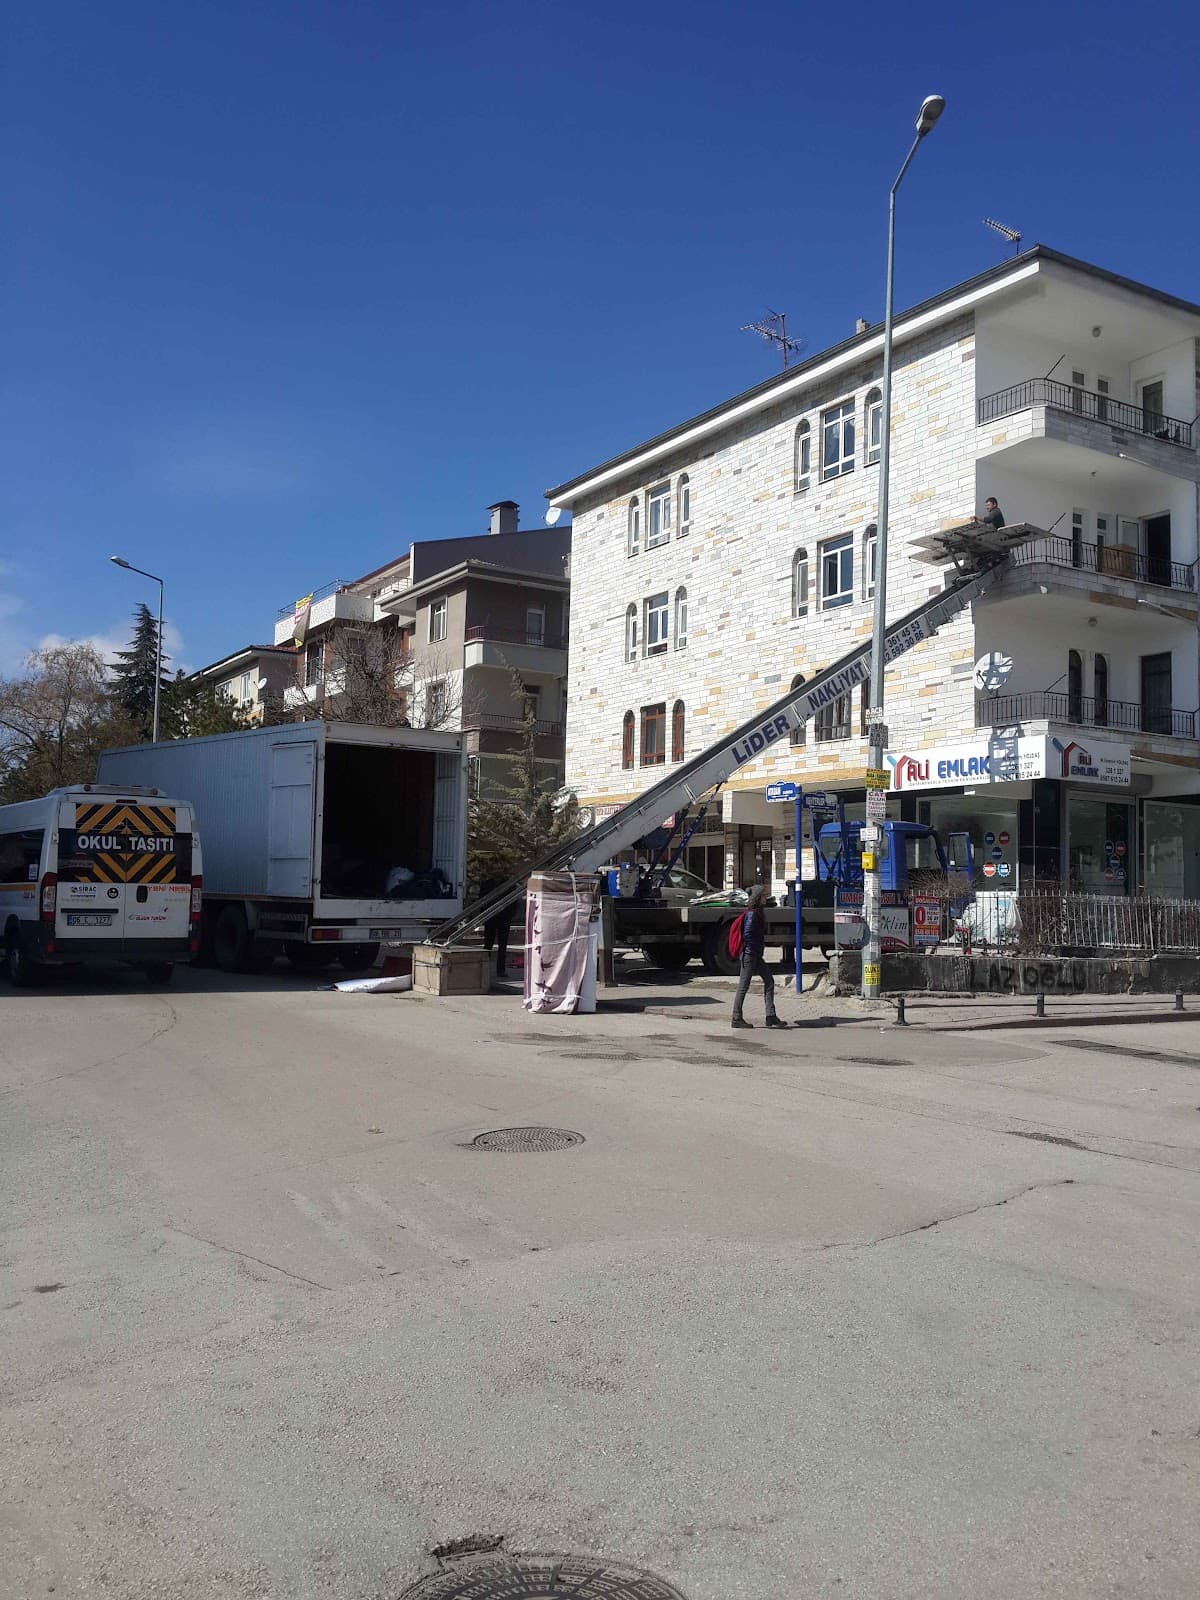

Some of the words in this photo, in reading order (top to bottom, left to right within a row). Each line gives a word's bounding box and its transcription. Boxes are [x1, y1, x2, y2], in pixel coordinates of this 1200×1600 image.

[937, 755, 991, 779] EMLAK
[77, 835, 121, 850] OKUL
[129, 836, 174, 853] TAŞITI
